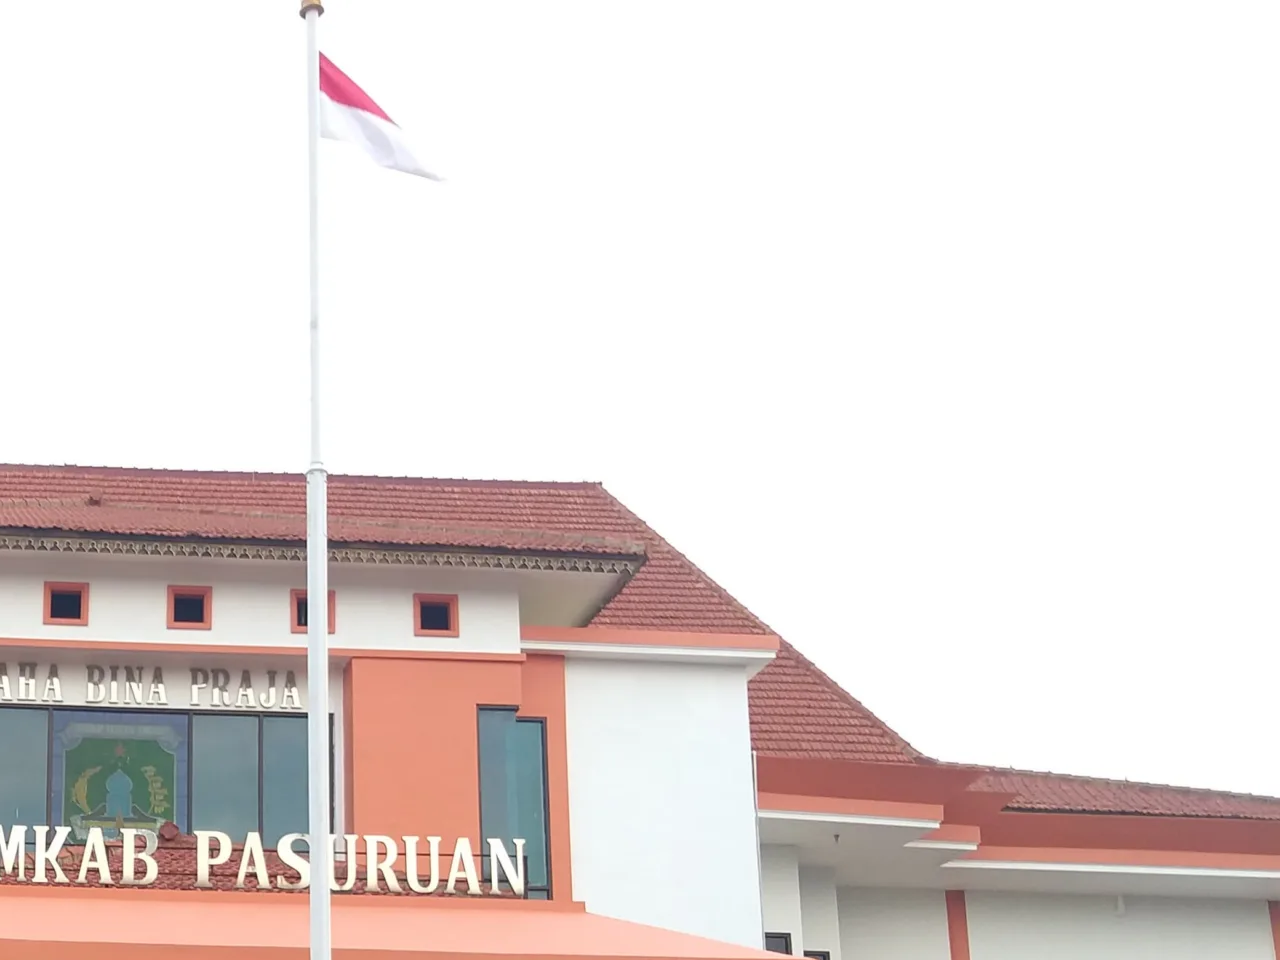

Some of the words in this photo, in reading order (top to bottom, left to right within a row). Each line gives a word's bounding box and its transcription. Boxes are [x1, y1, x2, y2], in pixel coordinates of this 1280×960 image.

[85, 664, 169, 706] BINA
[189, 667, 304, 709] PRAJA
[194, 830, 527, 895] PASURUAN
